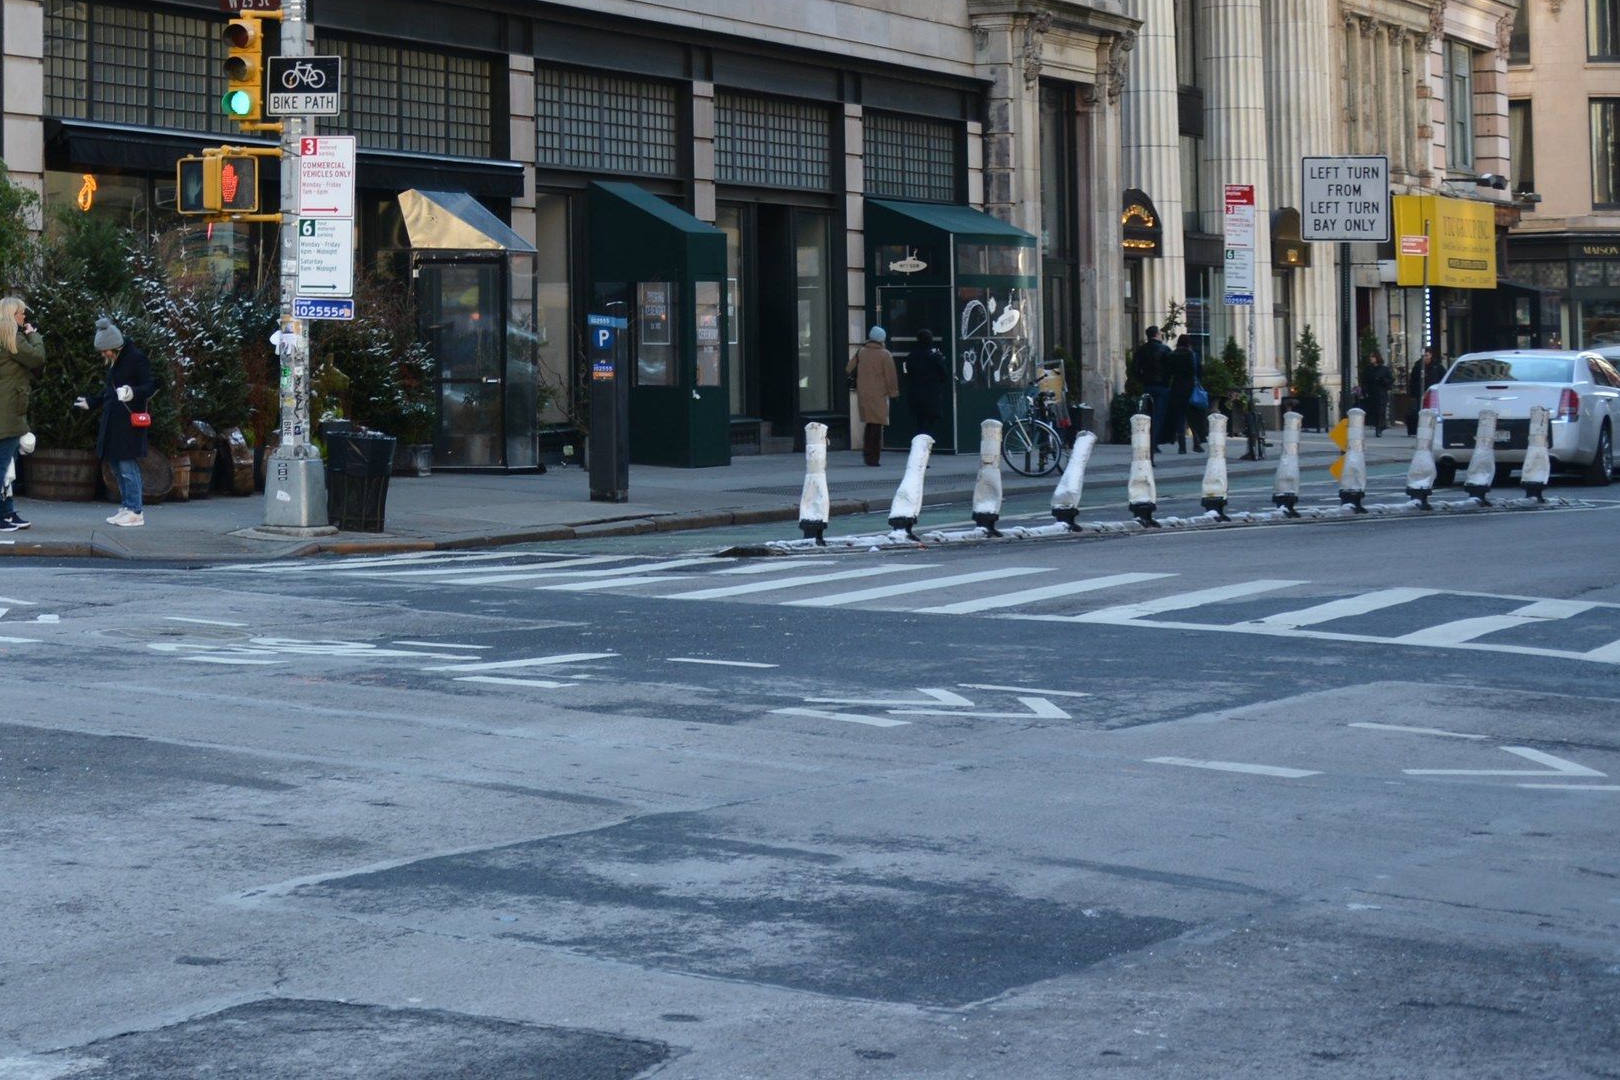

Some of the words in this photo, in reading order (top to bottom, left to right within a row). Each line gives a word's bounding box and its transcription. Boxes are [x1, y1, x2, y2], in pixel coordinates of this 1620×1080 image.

[273, 96, 298, 109] BIKE
[304, 96, 334, 109] PATH
[304, 139, 314, 155] 3
[302, 161, 346, 169] COMMERCIAL
[1310, 167, 1340, 179] LEFT
[1347, 167, 1379, 179] TURN
[1328, 184, 1361, 196] FROM
[1227, 205, 1233, 214] 3
[1310, 202, 1340, 214] LEFT
[1347, 202, 1379, 214] TURN
[302, 220, 312, 235] 6
[1314, 219, 1337, 231] BAY
[1345, 219, 1375, 231] ONLY
[1227, 250, 1233, 259] 6
[1583, 246, 1618, 255] MAISON
[301, 258, 323, 266] Saturday
[598, 329, 610, 347] P
